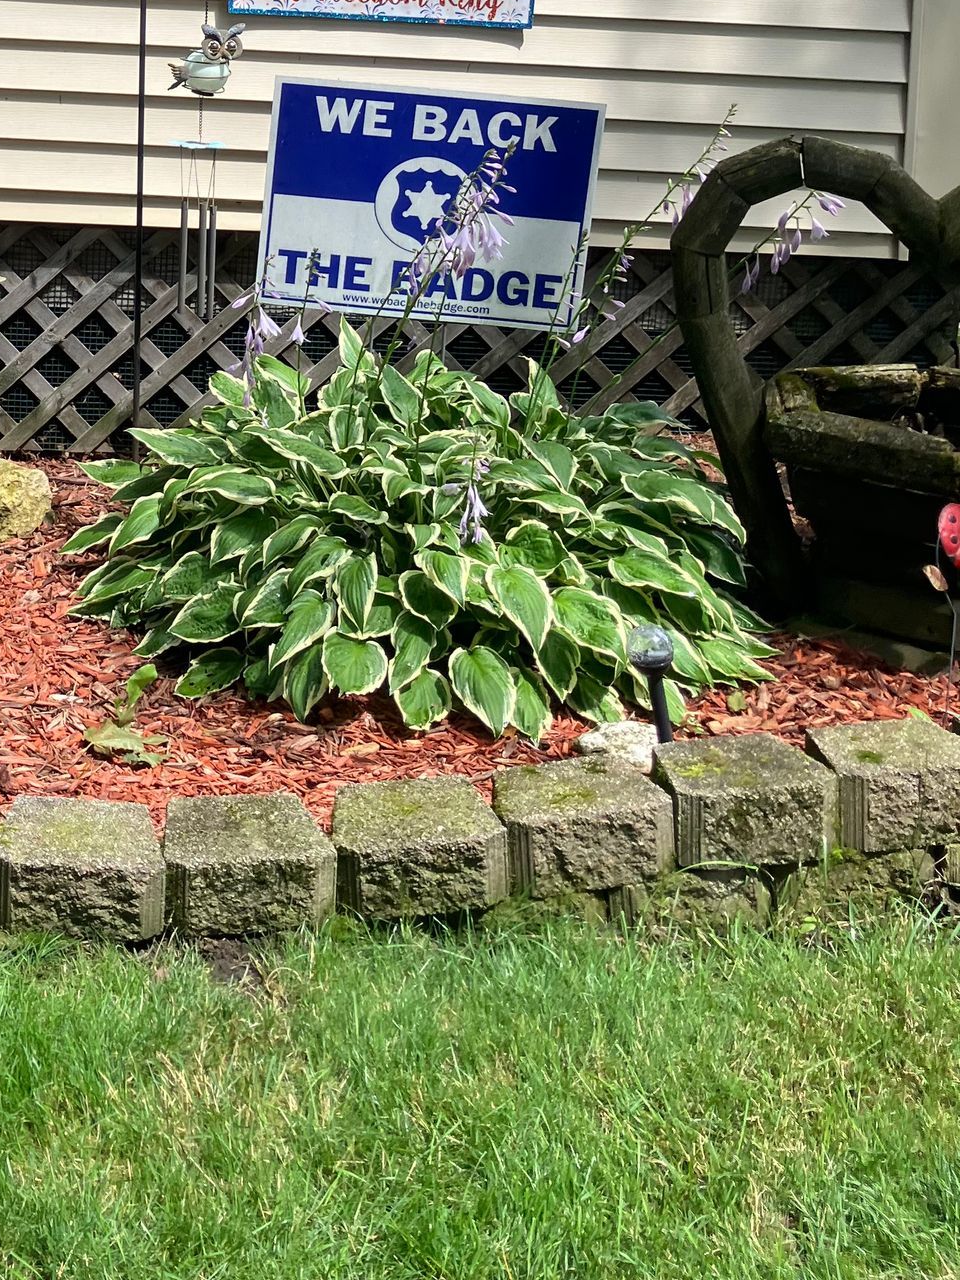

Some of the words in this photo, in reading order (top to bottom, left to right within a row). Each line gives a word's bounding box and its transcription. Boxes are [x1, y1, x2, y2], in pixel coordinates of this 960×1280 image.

[315, 95, 395, 139] WE
[412, 104, 560, 153] BACK
[278, 248, 373, 292] THE
